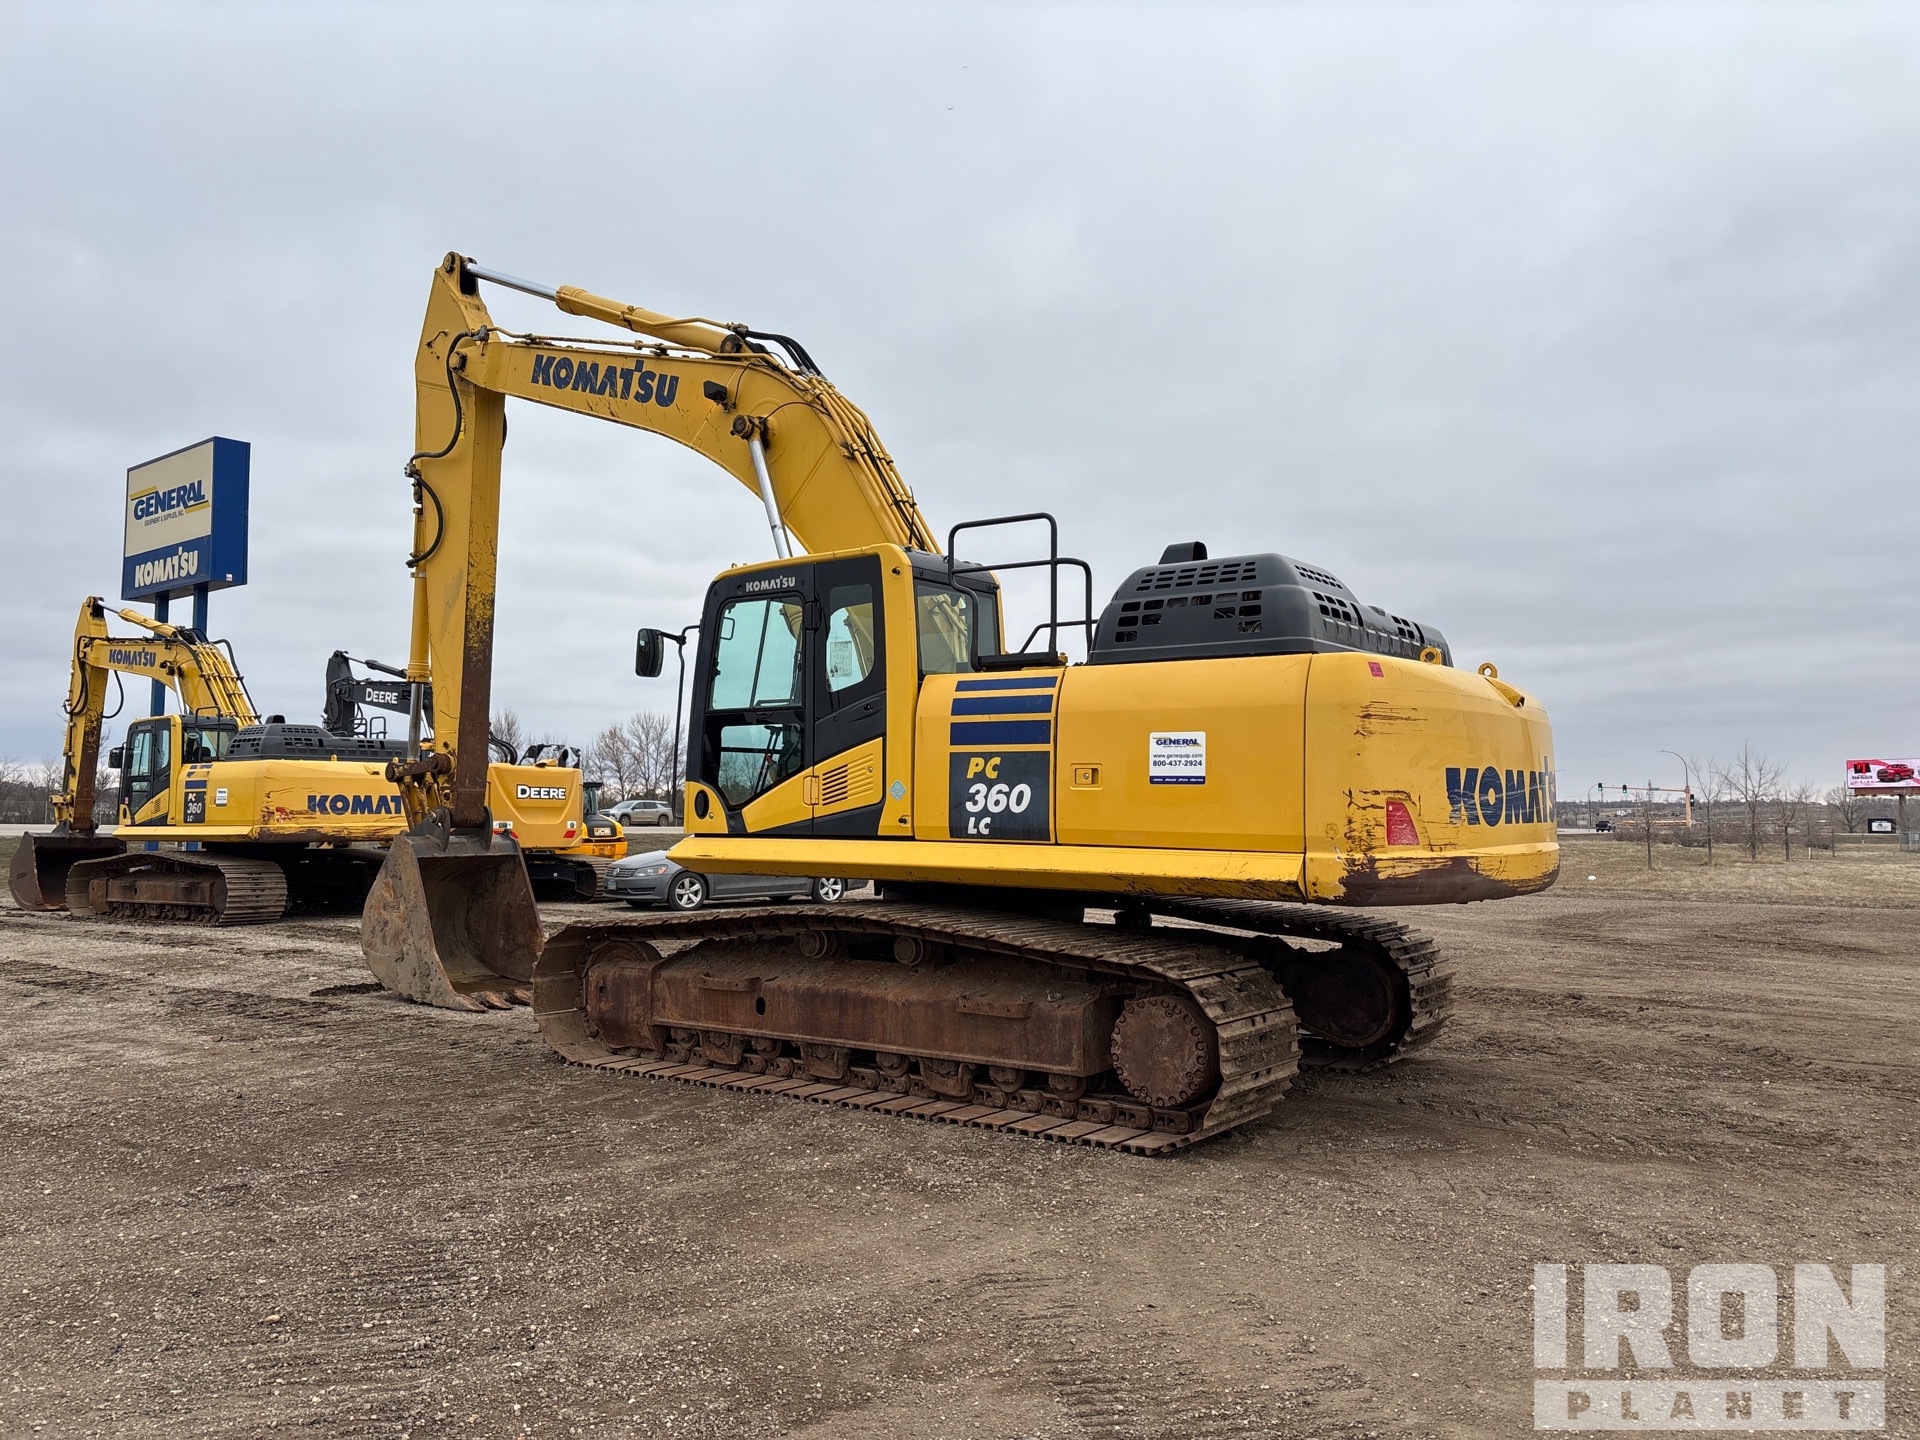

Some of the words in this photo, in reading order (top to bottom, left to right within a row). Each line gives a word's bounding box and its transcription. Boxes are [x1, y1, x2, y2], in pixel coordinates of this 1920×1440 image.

[531, 354, 679, 407] KOMATSU
[134, 480, 205, 520] GENERAL
[135, 547, 198, 588] KOMATSU
[745, 575, 796, 592] KOMATSU
[109, 647, 156, 667] KOMATSU
[365, 687, 399, 704] DEERE
[1155, 738, 1200, 746] GENERAL
[967, 757, 1002, 779] PC
[187, 793, 196, 802] PC
[517, 785, 566, 799] DEERE
[965, 783, 1032, 814] 360
[1445, 755, 1556, 827] KOMATS
[187, 802, 202, 814] 360
[967, 817, 992, 835] LC
